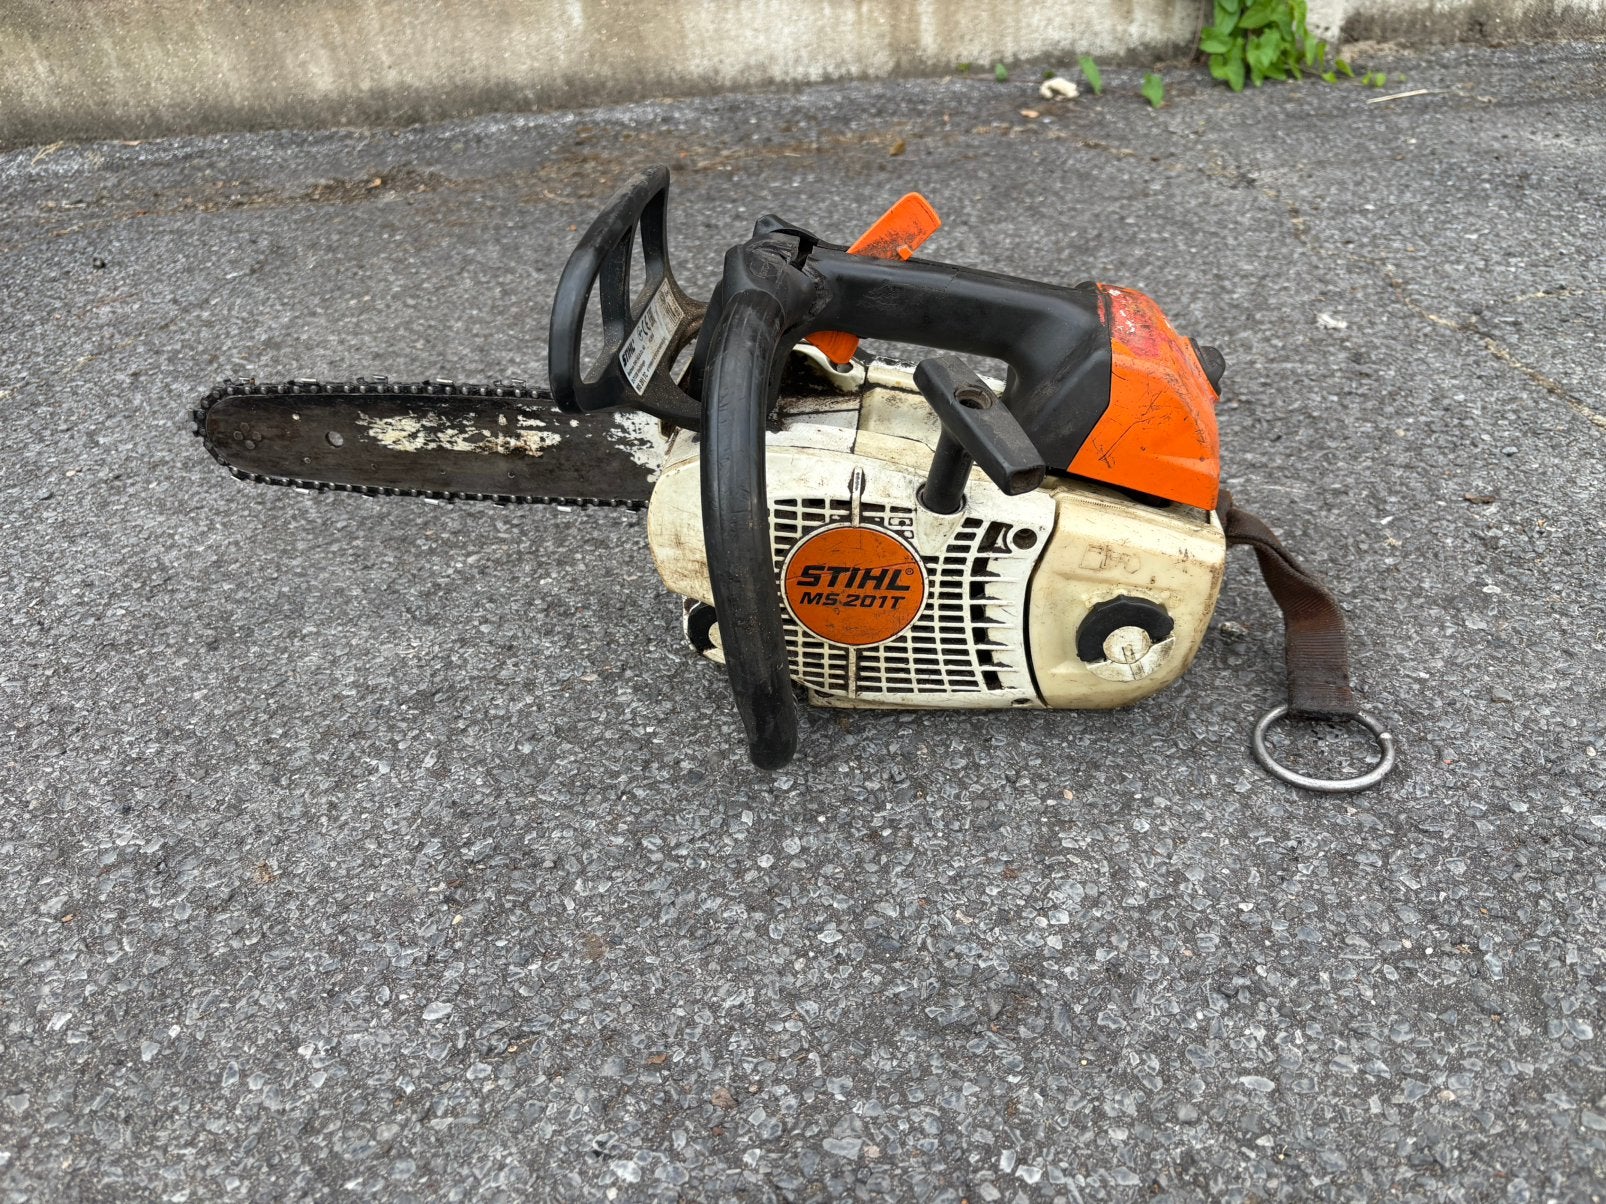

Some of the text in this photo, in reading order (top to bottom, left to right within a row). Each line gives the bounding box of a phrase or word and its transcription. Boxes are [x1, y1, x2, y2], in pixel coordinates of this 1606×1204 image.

[797, 565, 911, 591] STIHL
[800, 592, 905, 609] MS 201T
